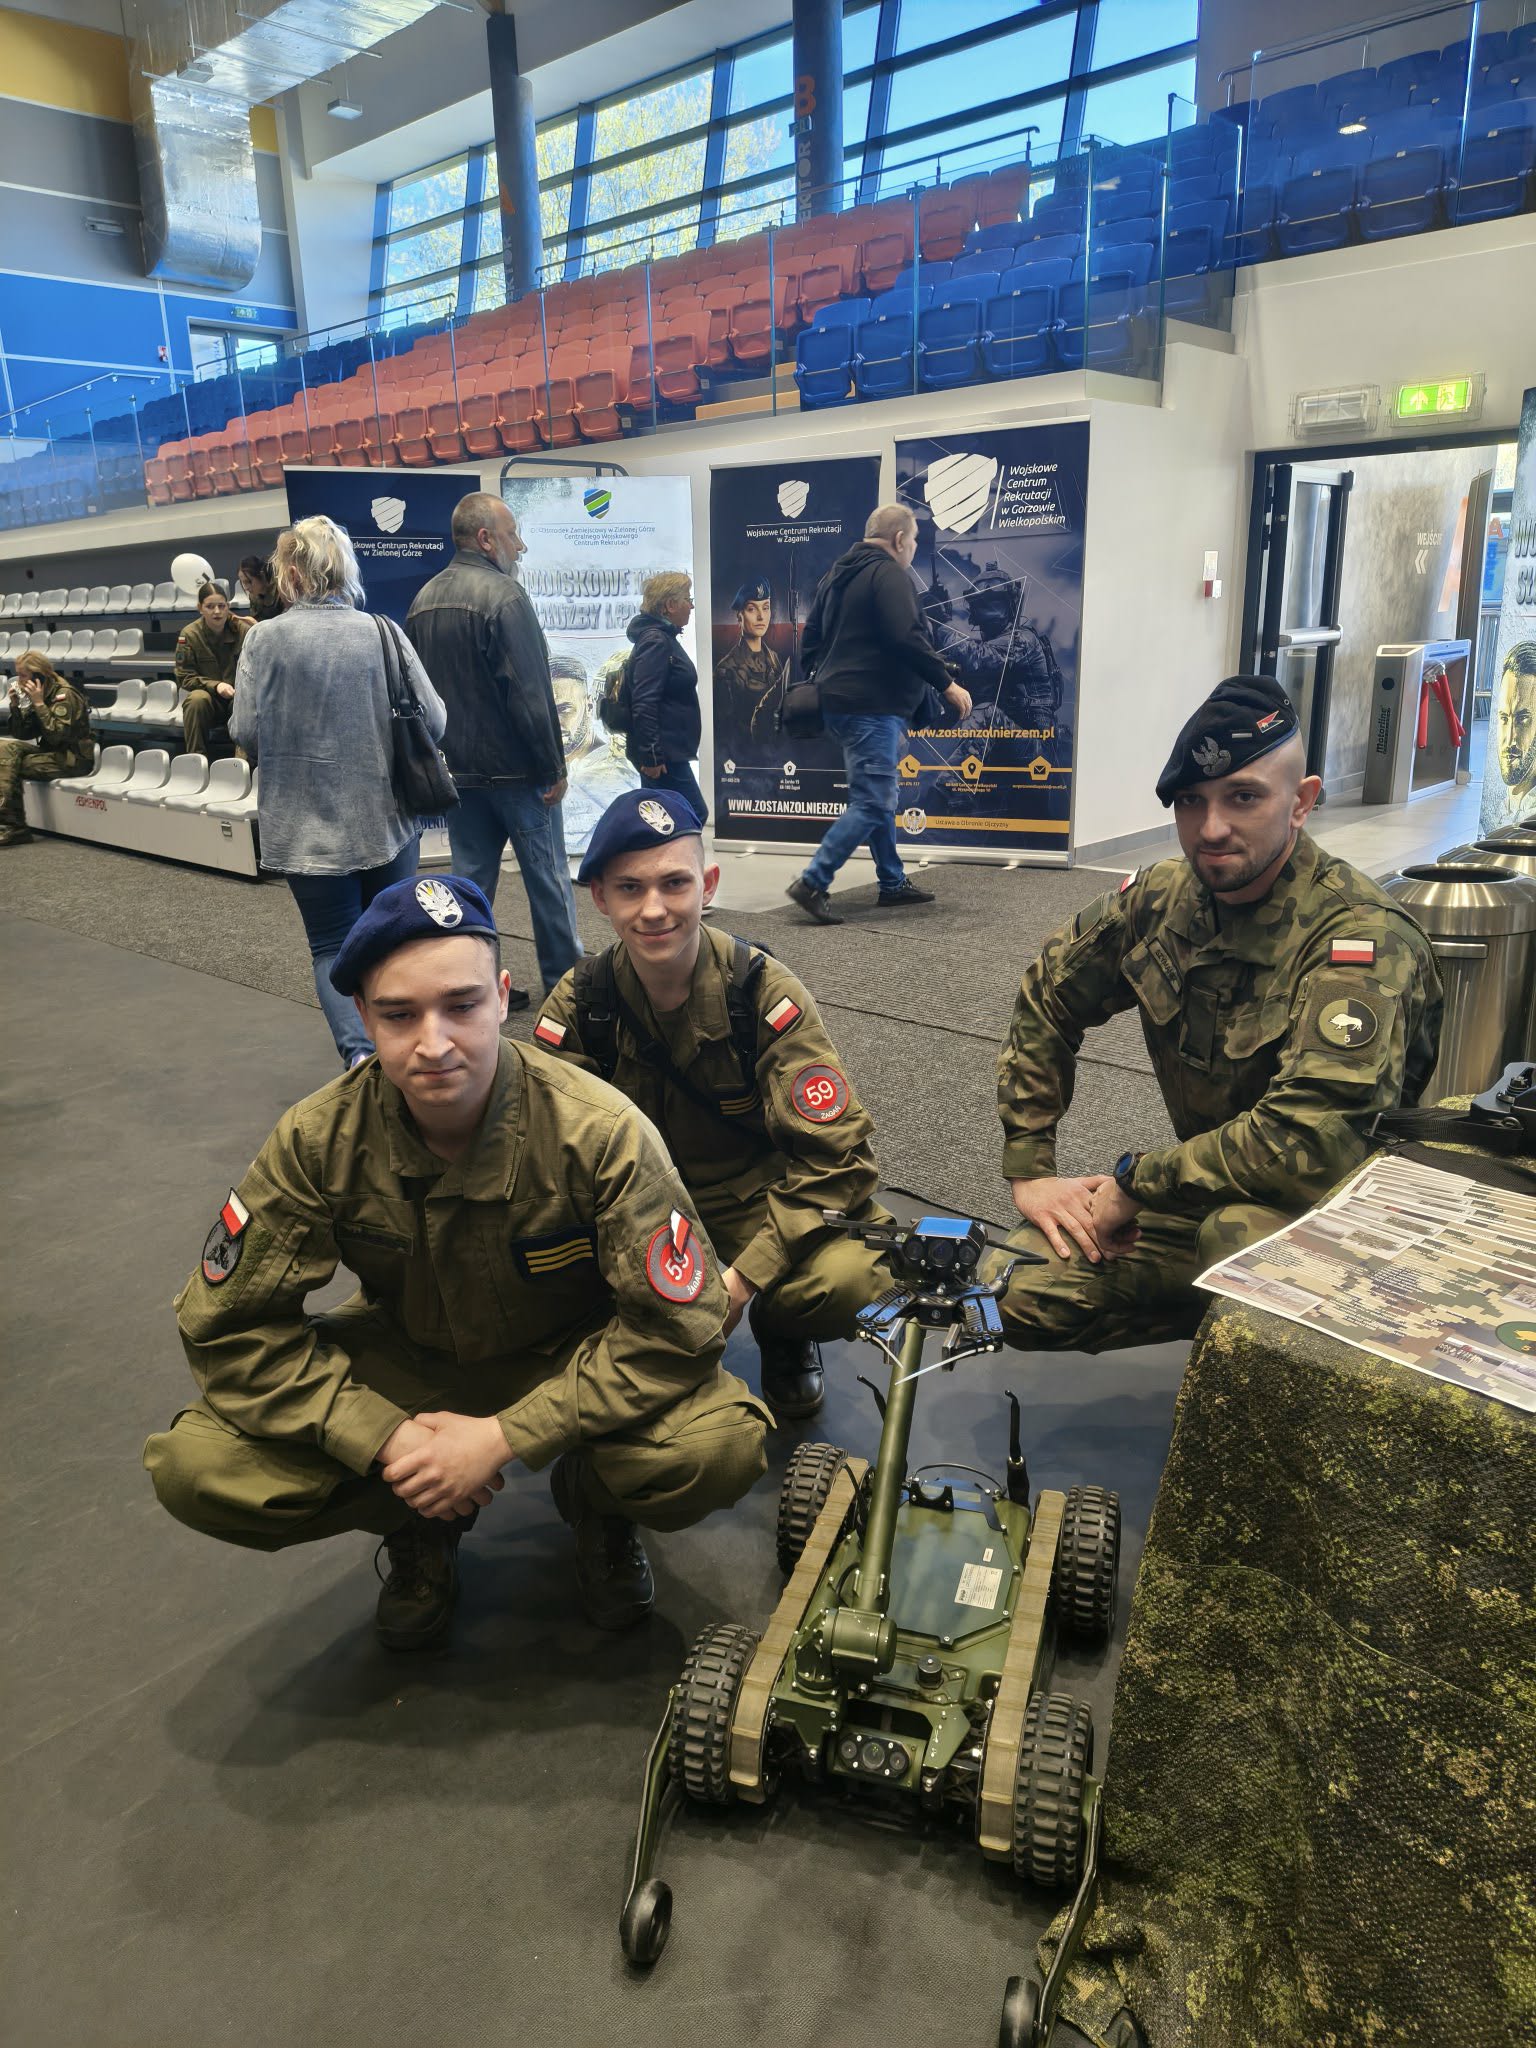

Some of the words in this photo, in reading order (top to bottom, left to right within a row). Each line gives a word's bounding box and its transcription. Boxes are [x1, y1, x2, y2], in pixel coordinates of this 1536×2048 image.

[795, 75, 816, 116] B
[799, 141, 812, 221] EKTOR
[1010, 463, 1058, 476] Wojskowe
[1007, 478, 1047, 489] Centrum
[1004, 488, 1052, 502] Rekrutacji
[1001, 507, 1010, 515] w
[1012, 502, 1056, 514] Gorzowie
[998, 514, 1066, 528] Wielkopolskim
[746, 529, 778, 538] Wojskowe
[780, 527, 807, 536] Centrum
[809, 525, 842, 533] Rekrutacji
[352, 541, 376, 549] skowe
[377, 541, 408, 549] Centrum
[409, 541, 444, 551] Rekrutacji
[372, 549, 400, 558] Zielonej
[402, 548, 423, 557] Górze
[907, 726, 1055, 740] www.zostanzolnierzem.pl
[728, 799, 848, 815] WWW.ZOSTANZOLNIERZEM
[1344, 1035, 1351, 1043] 5
[806, 1080, 834, 1106] 59
